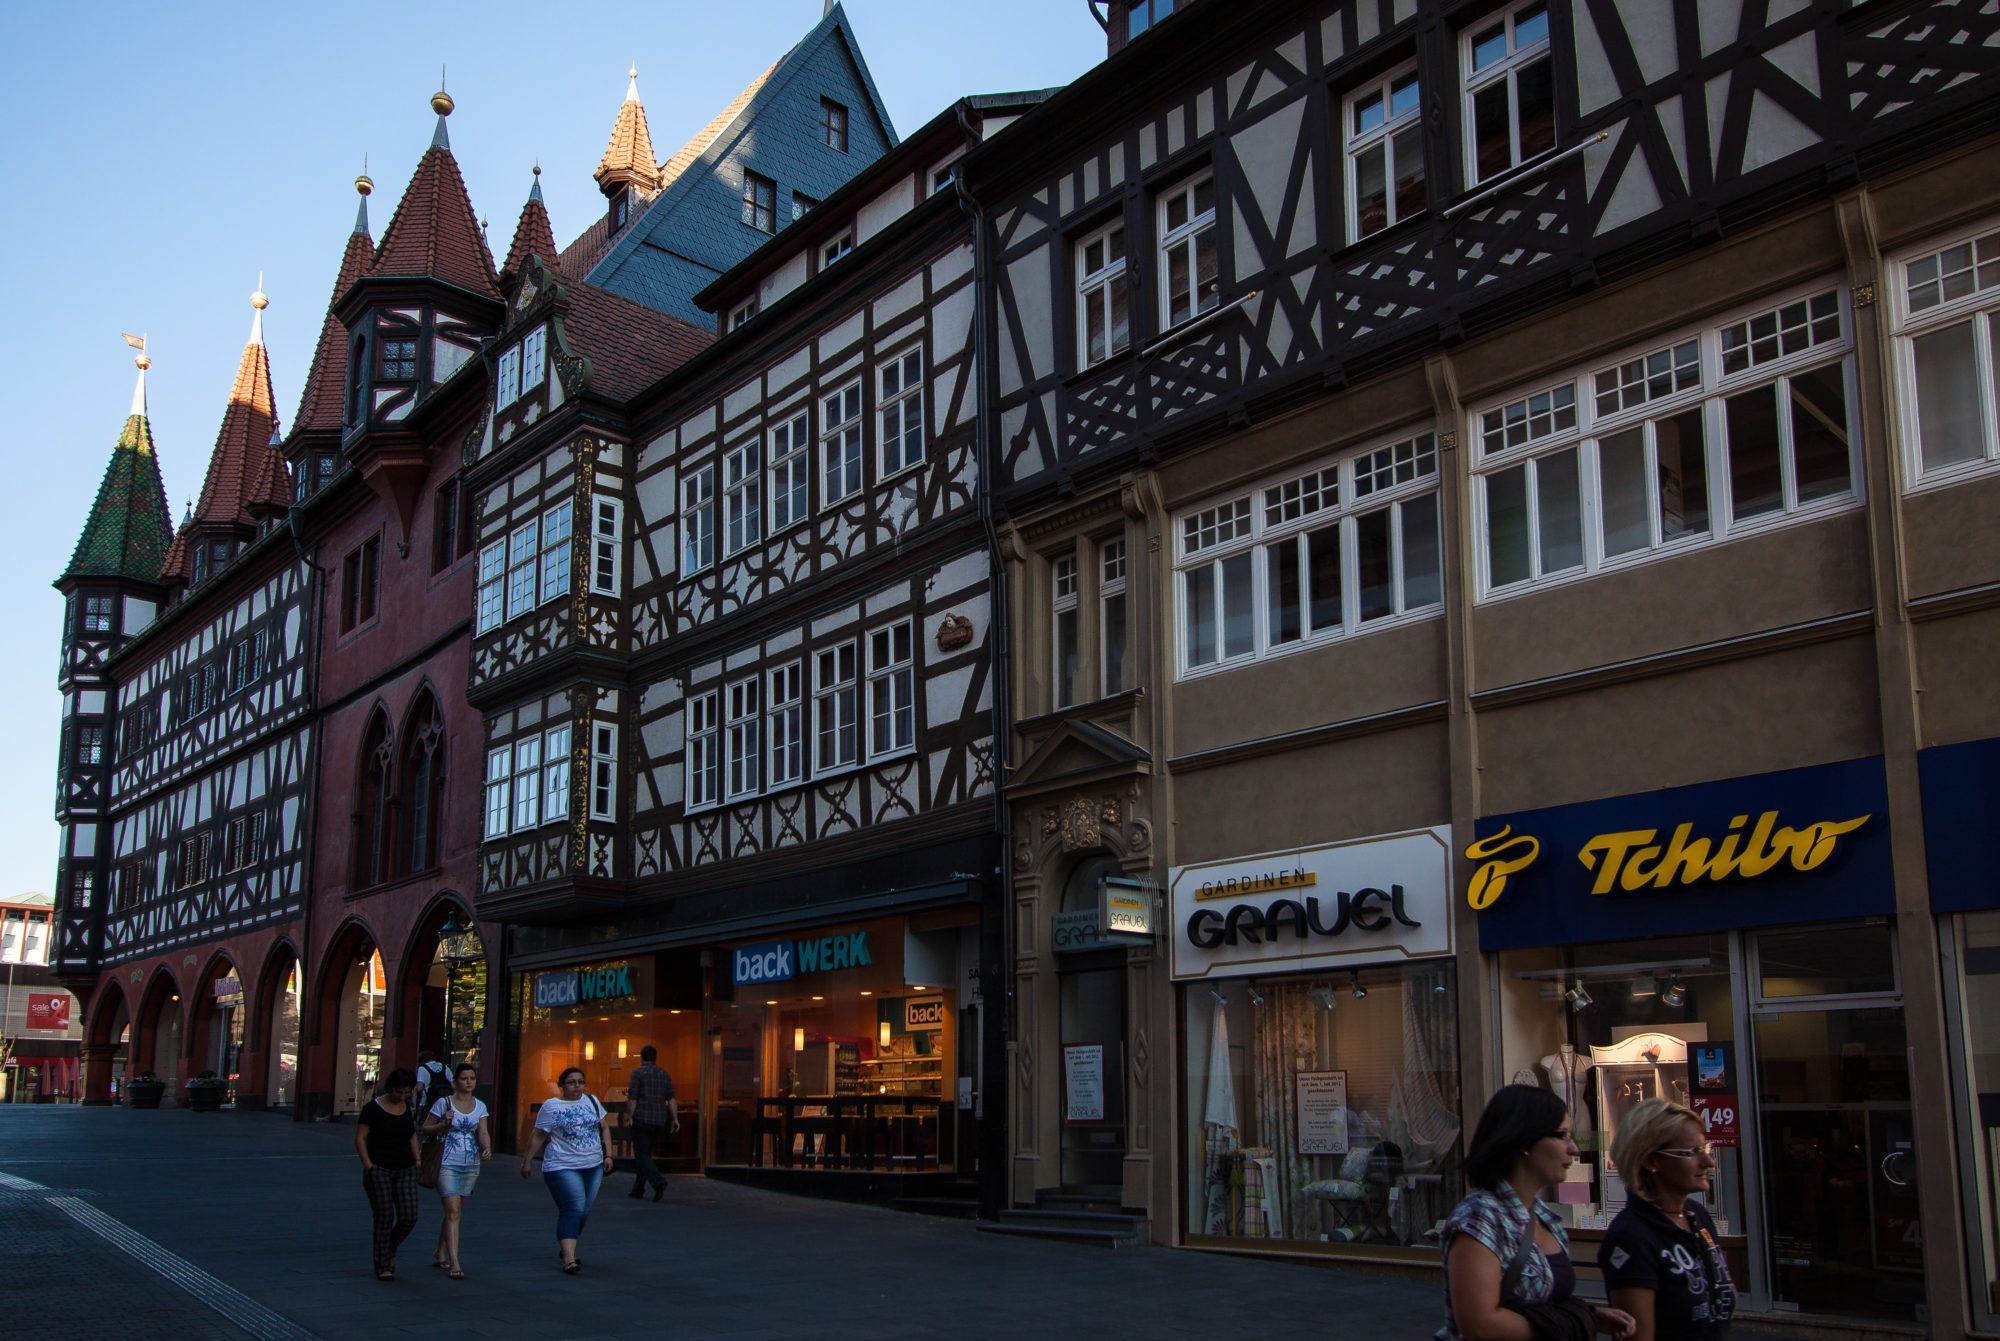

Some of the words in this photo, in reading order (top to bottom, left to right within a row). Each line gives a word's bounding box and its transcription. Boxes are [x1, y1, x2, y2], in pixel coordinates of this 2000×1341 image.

[1577, 810, 1872, 895] Tchibo
[1202, 868, 1306, 897] GARDINEN
[1187, 884, 1421, 948] GRAUEL
[1054, 923, 1099, 946] GRA
[736, 945, 791, 982] back
[797, 931, 873, 974] WERK
[537, 976, 577, 1005] back
[580, 967, 634, 1000] WERK
[32, 1003, 50, 1011] sale
[909, 1003, 943, 1023] back
